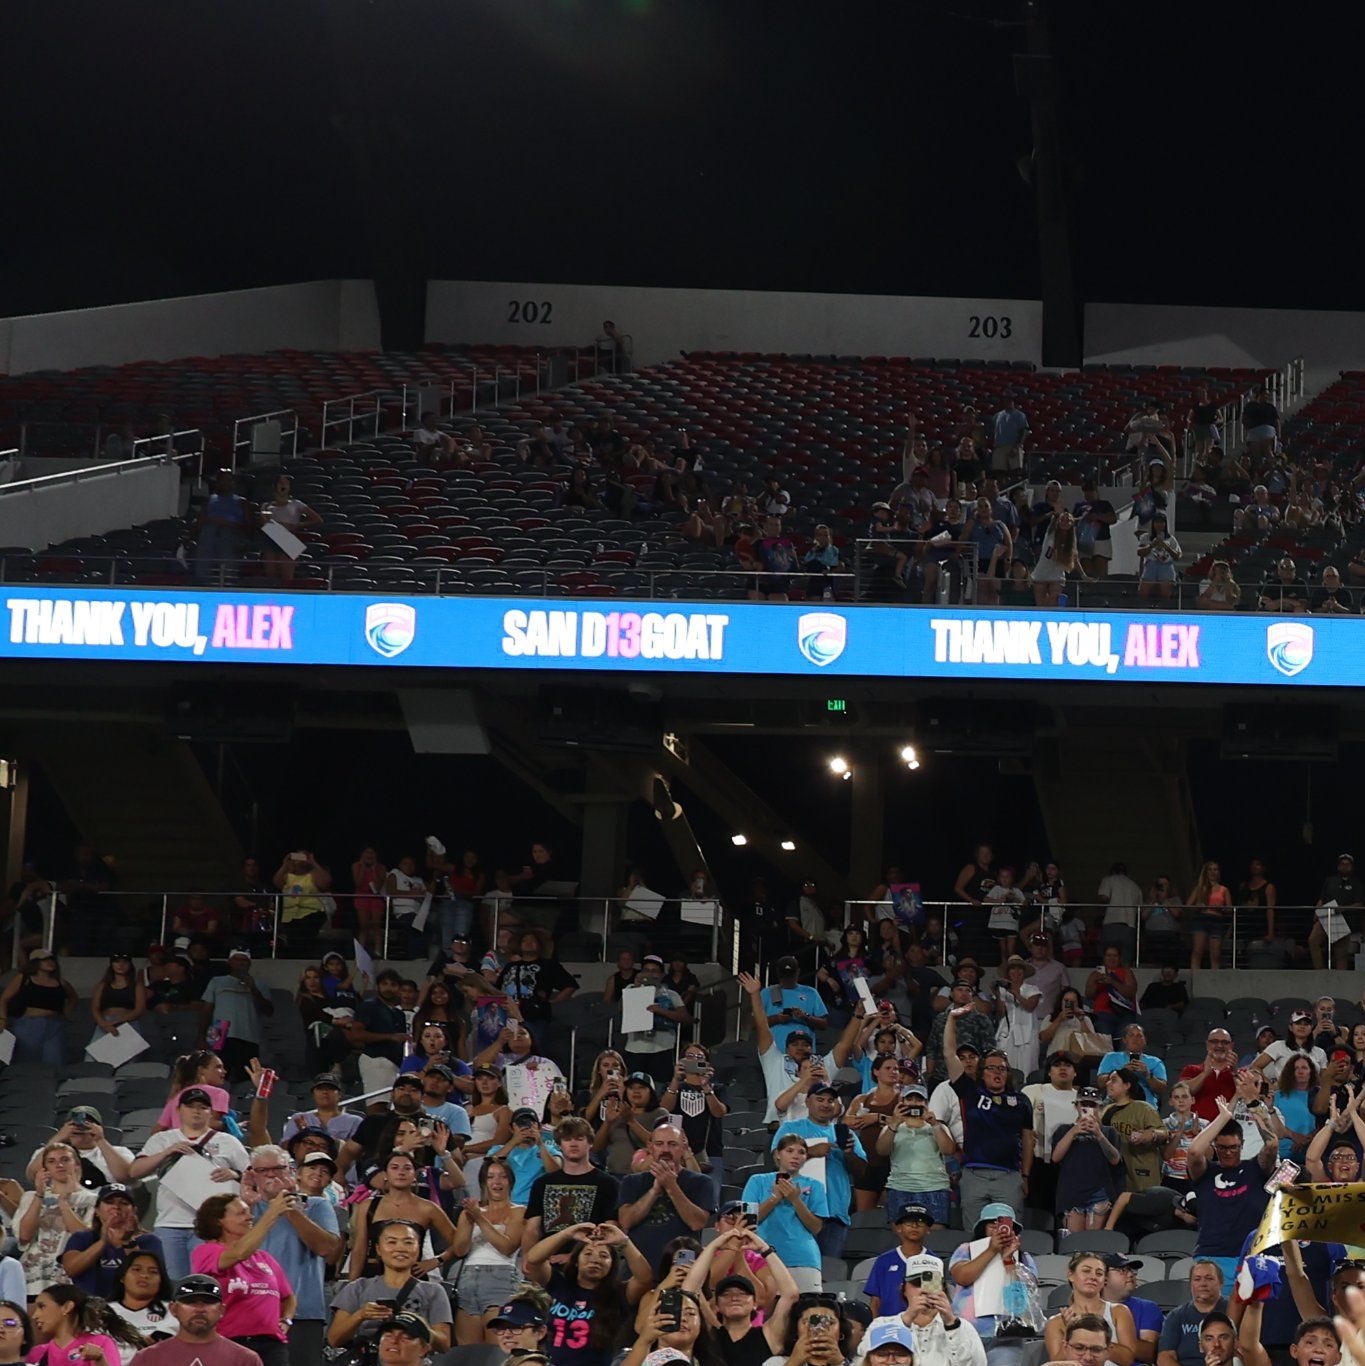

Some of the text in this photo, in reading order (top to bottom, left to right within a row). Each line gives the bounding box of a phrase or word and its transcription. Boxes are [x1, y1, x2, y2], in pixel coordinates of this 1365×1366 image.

[508, 299, 553, 326] 202
[968, 315, 1012, 340] 203
[7, 599, 294, 654] THANK YOU, ALEX
[503, 610, 728, 659] SAN D13GOAT
[931, 620, 1199, 673] THANK YOU, ALEX
[977, 1095, 993, 1111] 13
[1282, 1204, 1327, 1219] YOU
[912, 1260, 939, 1268] ALOHA
[553, 1318, 590, 1349] 13
[1181, 1324, 1200, 1335] WA
